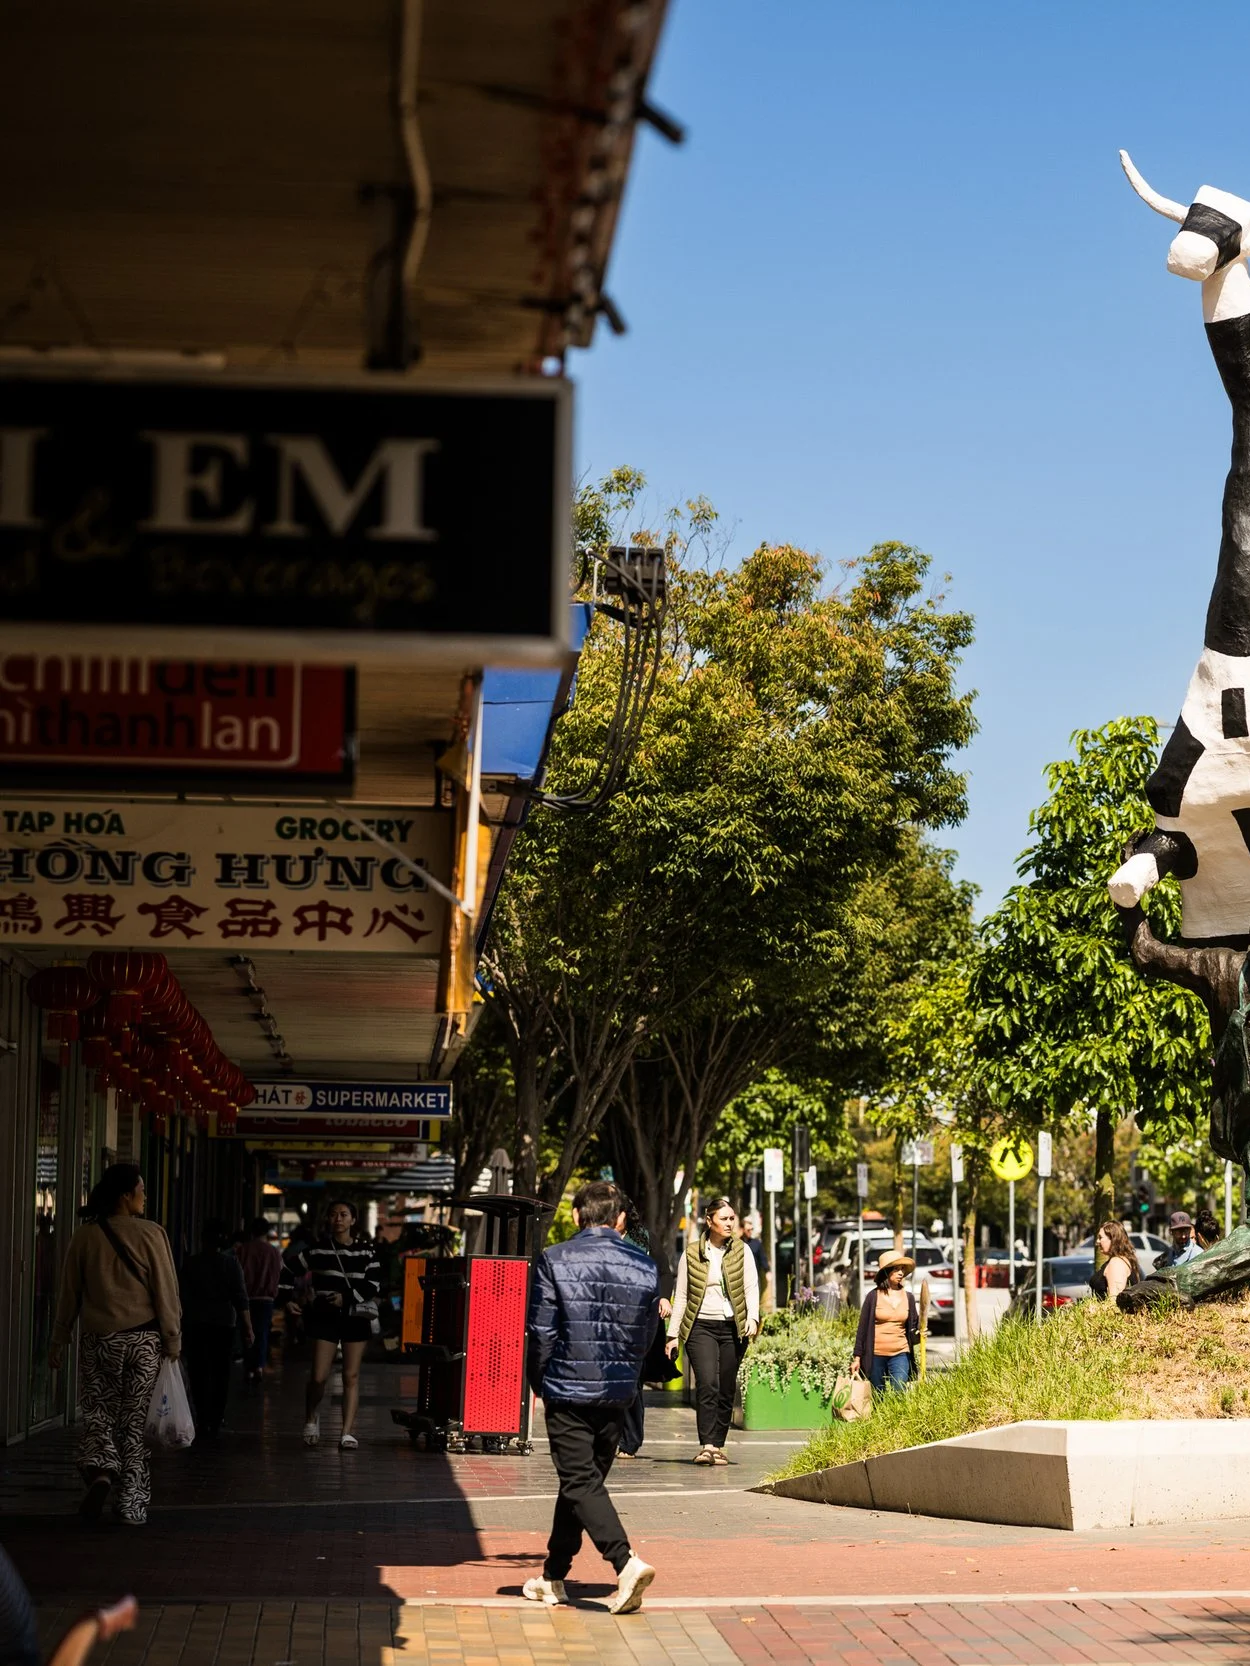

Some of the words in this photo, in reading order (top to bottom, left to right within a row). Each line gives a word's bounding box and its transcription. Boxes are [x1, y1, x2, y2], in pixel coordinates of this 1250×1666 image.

[137, 427, 441, 543] EM
[3, 811, 55, 836] TẠP
[275, 816, 414, 842] GROCERY
[215, 847, 429, 891] HƯNG
[255, 1086, 292, 1104] HÁT
[316, 1089, 448, 1108] SUPERMARKET
